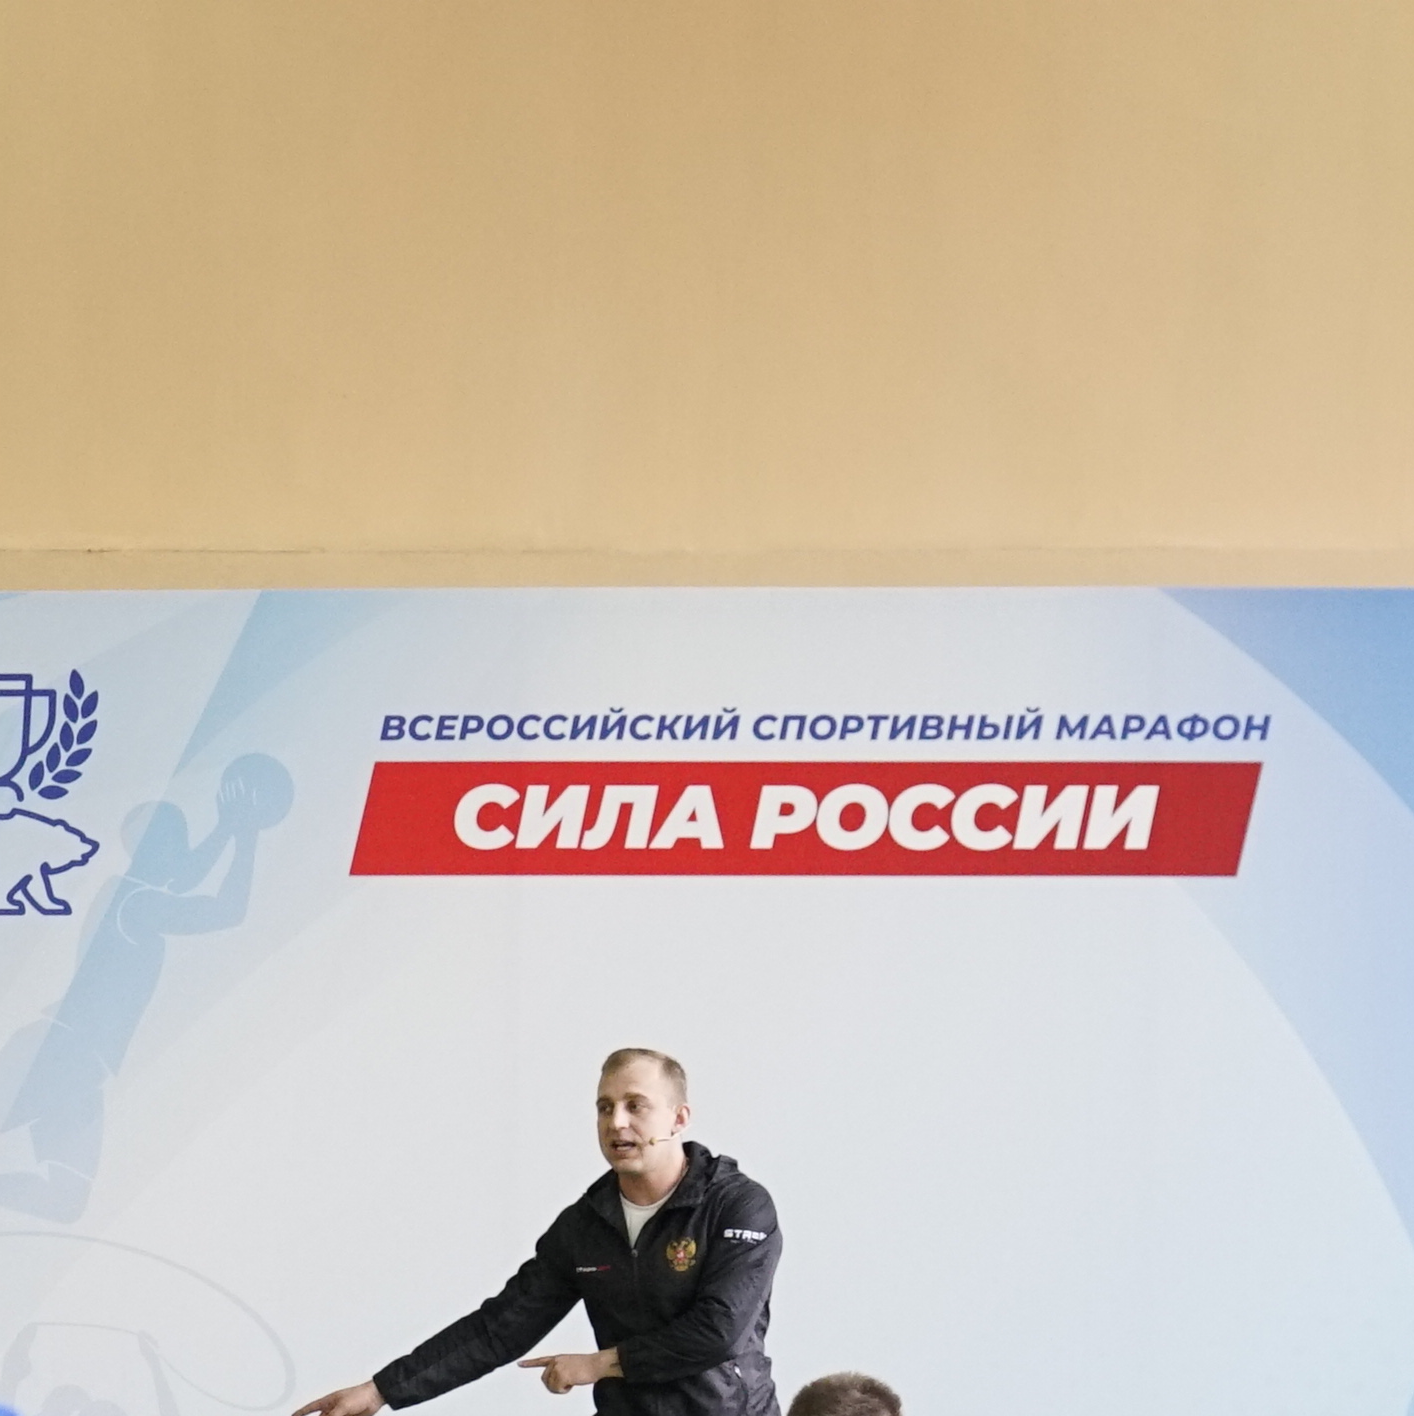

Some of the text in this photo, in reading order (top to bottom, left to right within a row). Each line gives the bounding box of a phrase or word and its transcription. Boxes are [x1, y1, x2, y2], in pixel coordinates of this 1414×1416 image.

[380, 706, 1272, 742] ВСЕРОССИЙСКИЙ СПОРТИВНЫЙ МАРАФОН
[453, 782, 1160, 851] СИЛА РОССИИ
